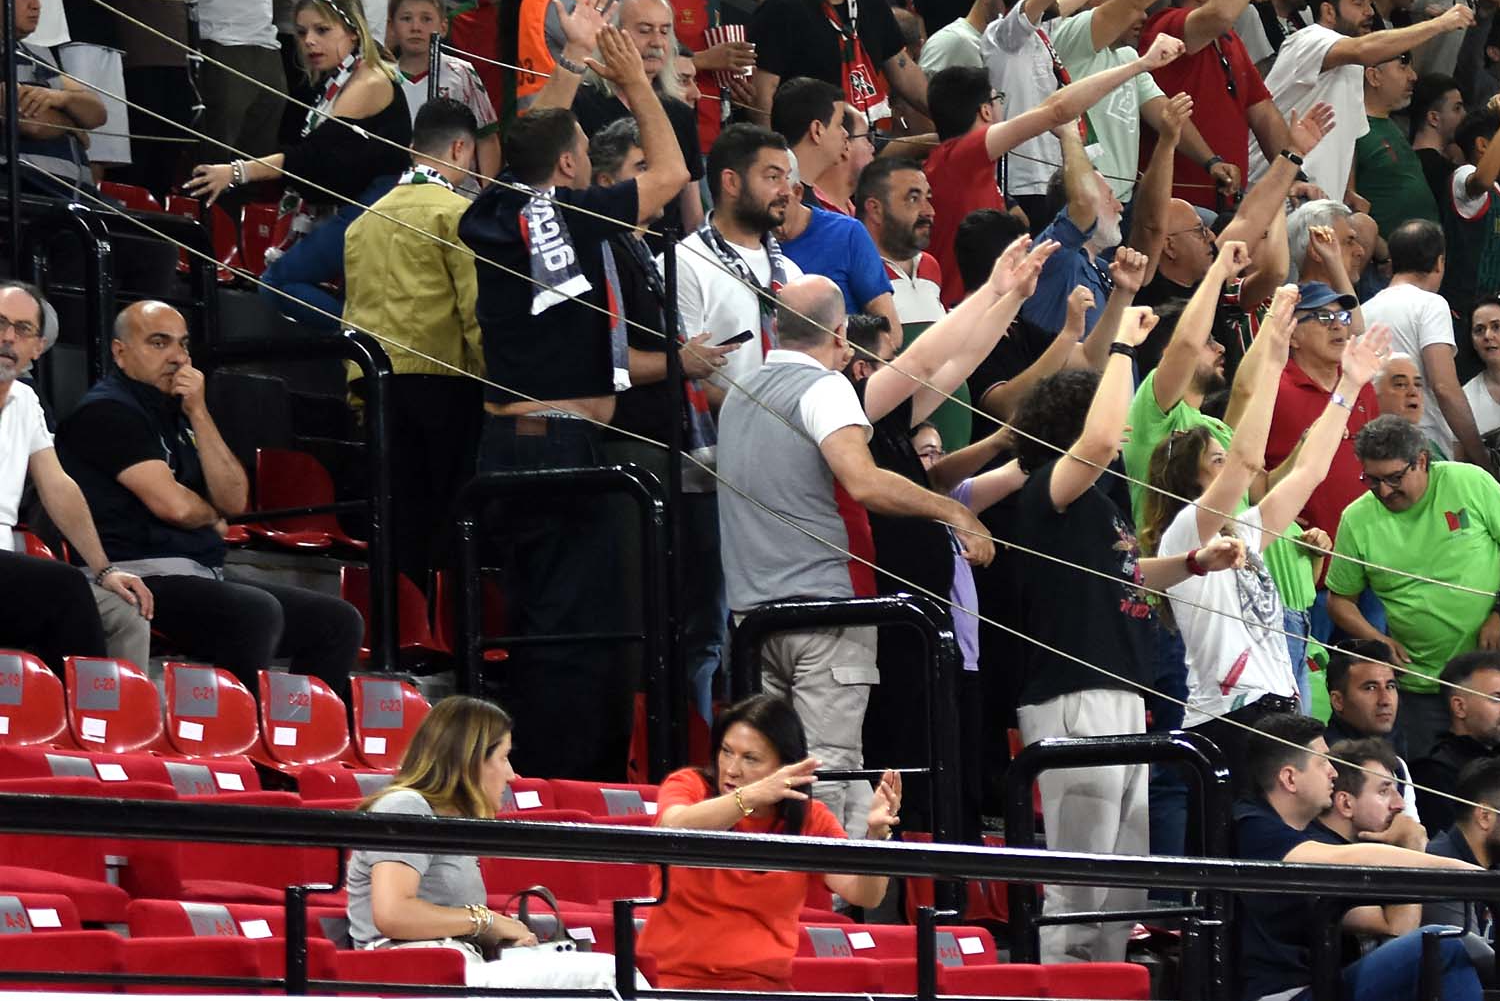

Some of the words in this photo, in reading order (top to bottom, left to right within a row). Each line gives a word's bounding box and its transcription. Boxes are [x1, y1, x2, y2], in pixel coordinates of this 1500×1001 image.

[93, 677, 116, 691] C-20
[192, 686, 215, 699] C-21
[380, 699, 401, 711] C-23
